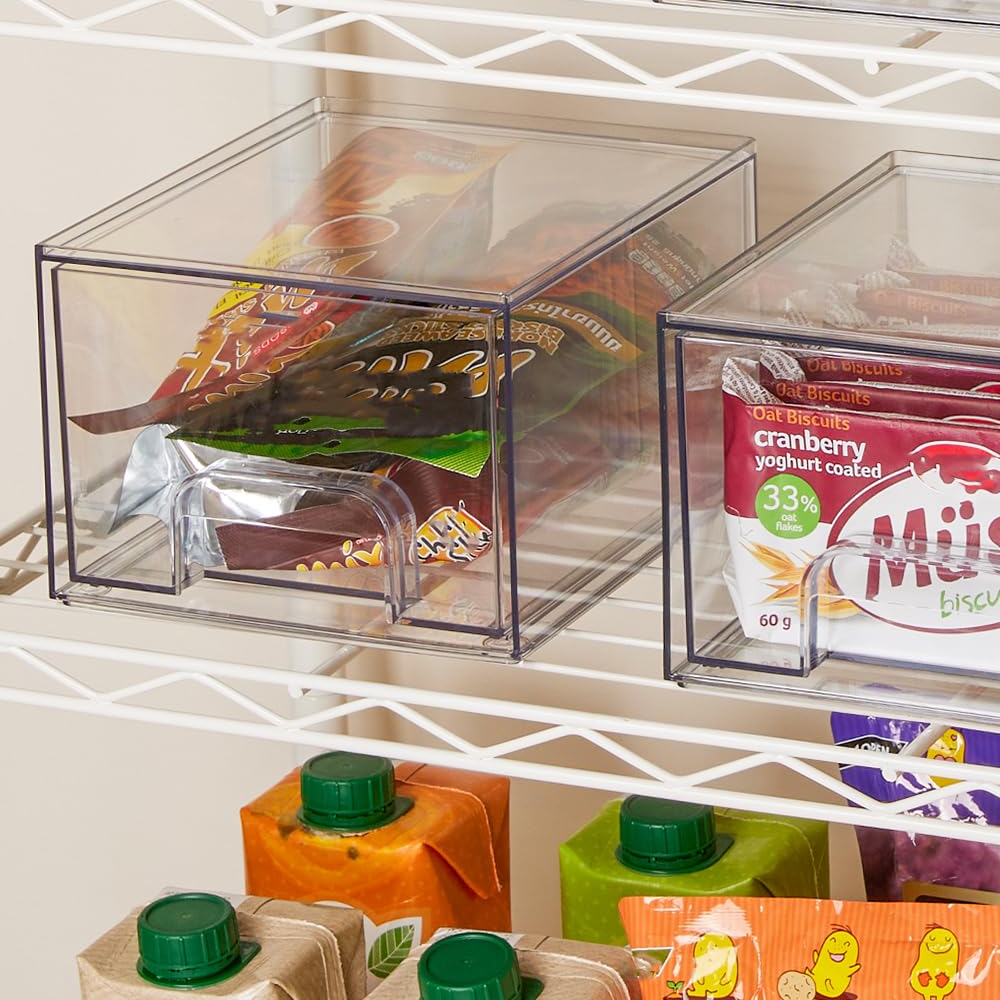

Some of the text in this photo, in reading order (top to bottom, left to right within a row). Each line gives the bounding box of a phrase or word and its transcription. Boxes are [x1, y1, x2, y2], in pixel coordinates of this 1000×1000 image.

[841, 359, 903, 377] Biscuits
[776, 382, 803, 398] Oat
[806, 383, 871, 407] Biscuits
[752, 405, 850, 431] Oat Biscuits
[754, 429, 867, 463] cranberry
[755, 453, 882, 479] yoghurt coated
[763, 484, 818, 514] 33%
[775, 521, 803, 533] flakes
[781, 514, 797, 522] oat
[759, 614, 792, 630] 60 g
